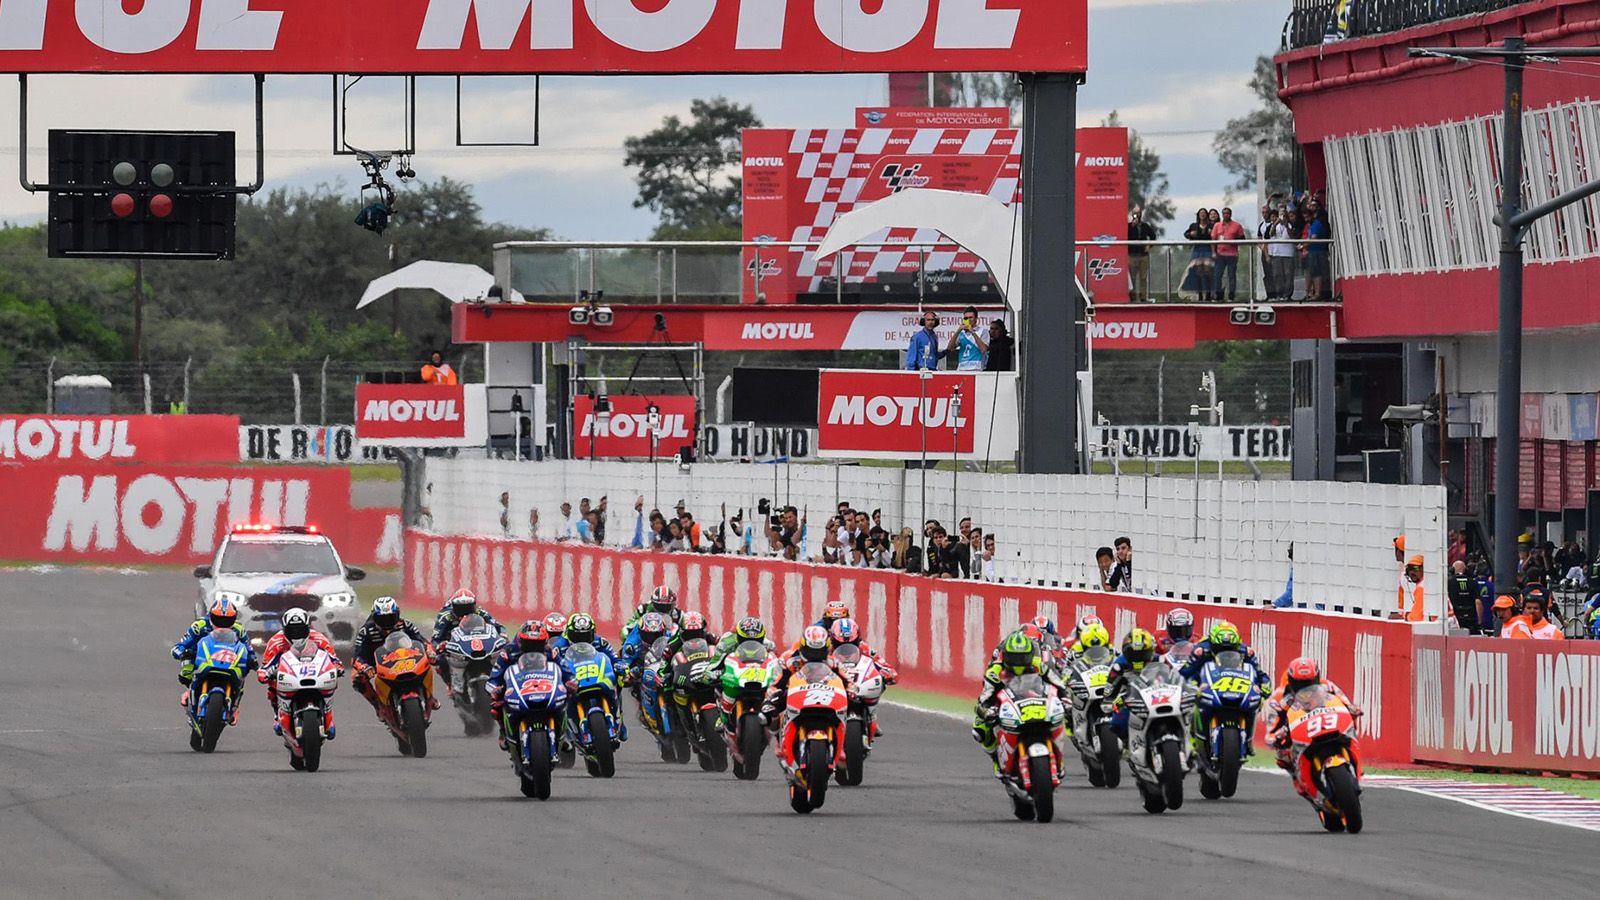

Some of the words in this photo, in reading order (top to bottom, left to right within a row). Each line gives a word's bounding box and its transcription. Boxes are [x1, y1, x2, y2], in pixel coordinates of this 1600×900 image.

[926, 117, 1003, 125] MOTOCYCLISME
[745, 157, 784, 167] MOTUL
[1085, 156, 1124, 167] MOTUL
[741, 322, 815, 340] MOTUL
[885, 331, 897, 341] DE
[1086, 321, 1158, 339] MOTUL
[363, 399, 460, 422] MOTUL
[827, 394, 967, 428] MOTUL
[580, 413, 689, 439] MOTUL
[248, 427, 282, 461] DE
[730, 426, 809, 458] HOND
[299, 666, 317, 677] 45
[575, 664, 599, 681] 29
[519, 679, 554, 696] 25
[1211, 676, 1252, 693] 46
[1453, 649, 1513, 756] MOTUL
[1306, 713, 1339, 739] 93
